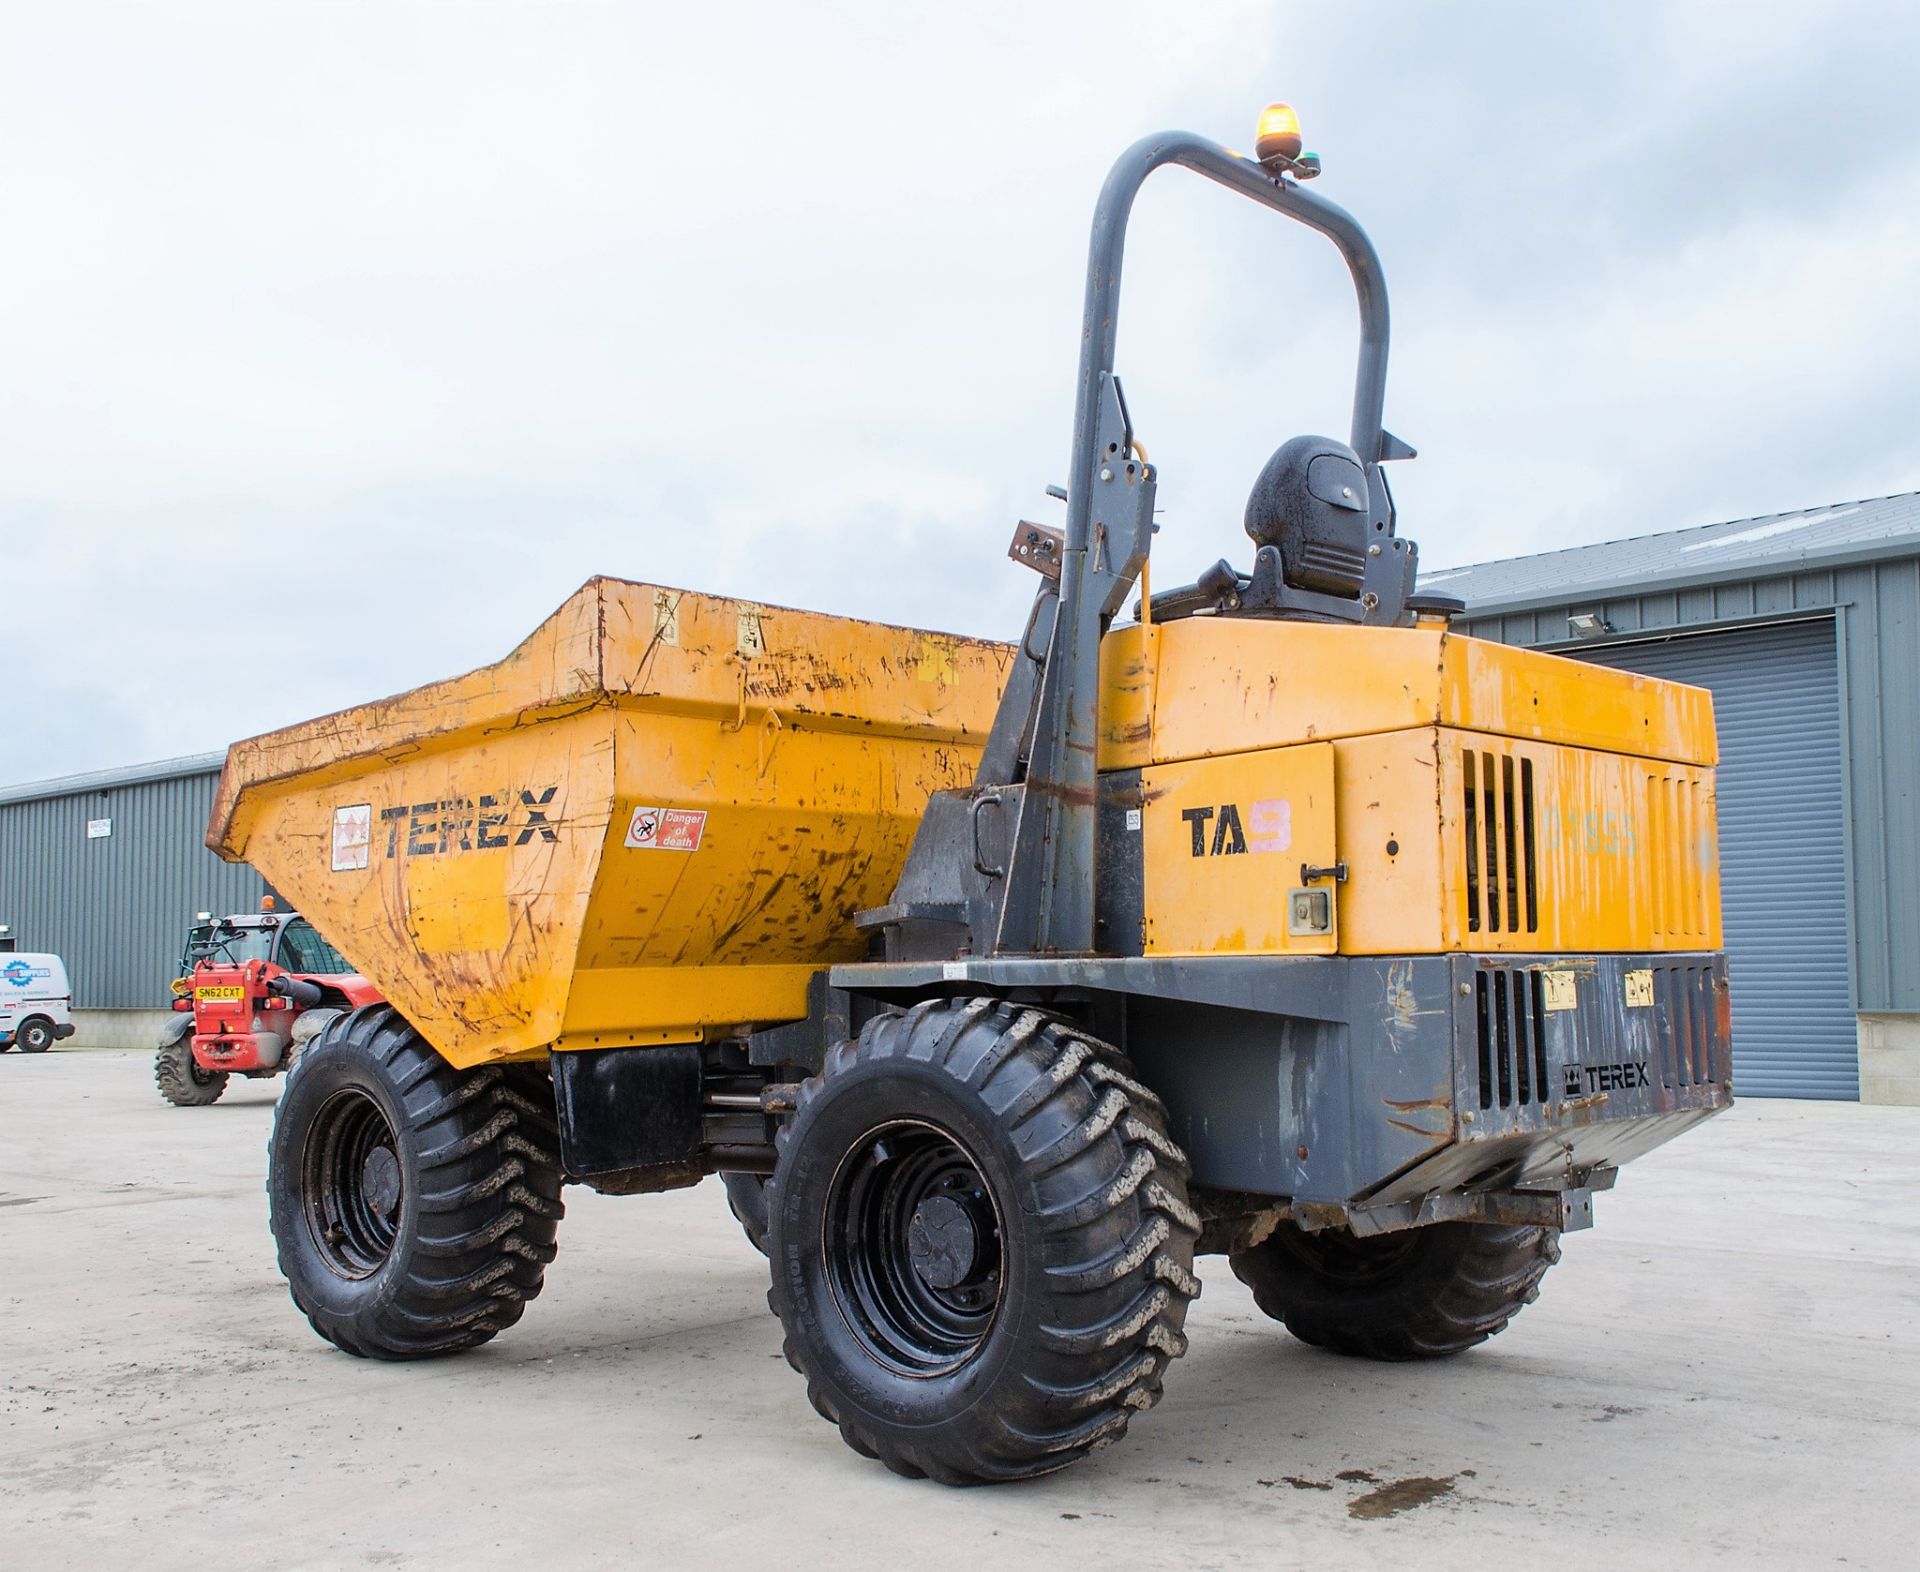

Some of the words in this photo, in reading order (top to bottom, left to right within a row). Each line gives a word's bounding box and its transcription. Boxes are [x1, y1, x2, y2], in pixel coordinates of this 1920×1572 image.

[381, 786, 558, 858] TEREX
[665, 812, 703, 825] Danger
[675, 826, 688, 835] of
[1182, 799, 1292, 857] TA9
[663, 836, 693, 848] death
[200, 988, 222, 997] SN62
[223, 988, 241, 997] CXT
[1585, 1062, 1650, 1093] TEREX
